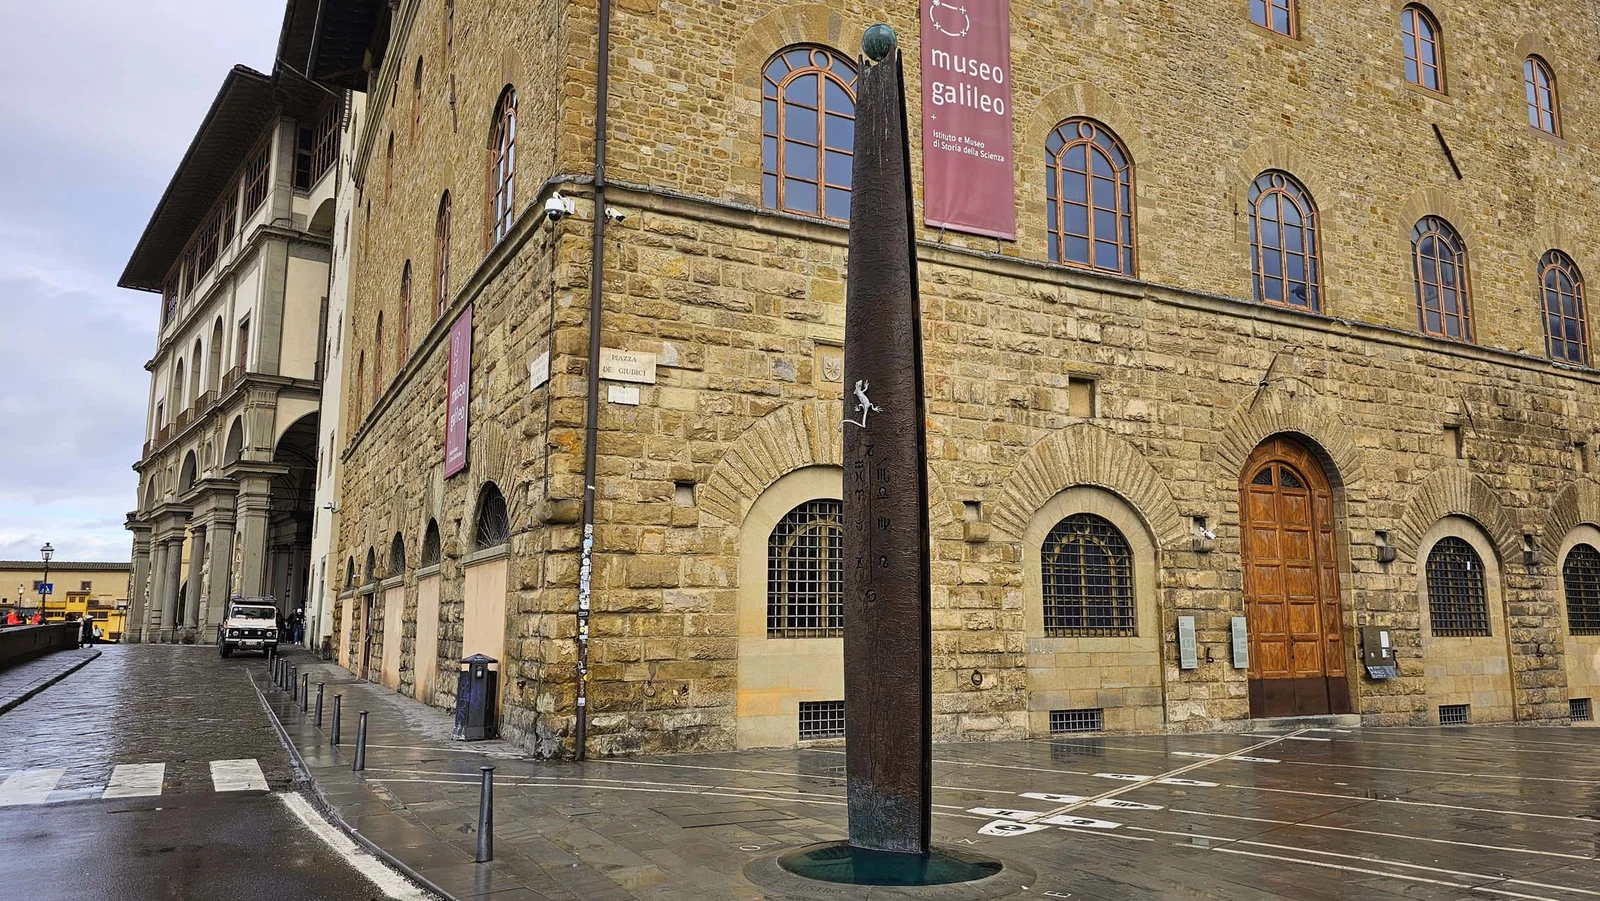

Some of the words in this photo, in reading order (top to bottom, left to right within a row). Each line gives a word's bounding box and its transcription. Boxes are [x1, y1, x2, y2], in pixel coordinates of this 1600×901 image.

[931, 48, 1004, 84] museo
[931, 81, 1005, 115] galileo
[933, 129, 956, 142] Istituto
[964, 136, 985, 149] Museo
[933, 139, 940, 148] di
[941, 141, 961, 152] Storia
[963, 145, 979, 157] della
[980, 149, 1005, 162] Scienza
[611, 354, 637, 363] PIAZZA
[618, 367, 646, 377] GIUDICI
